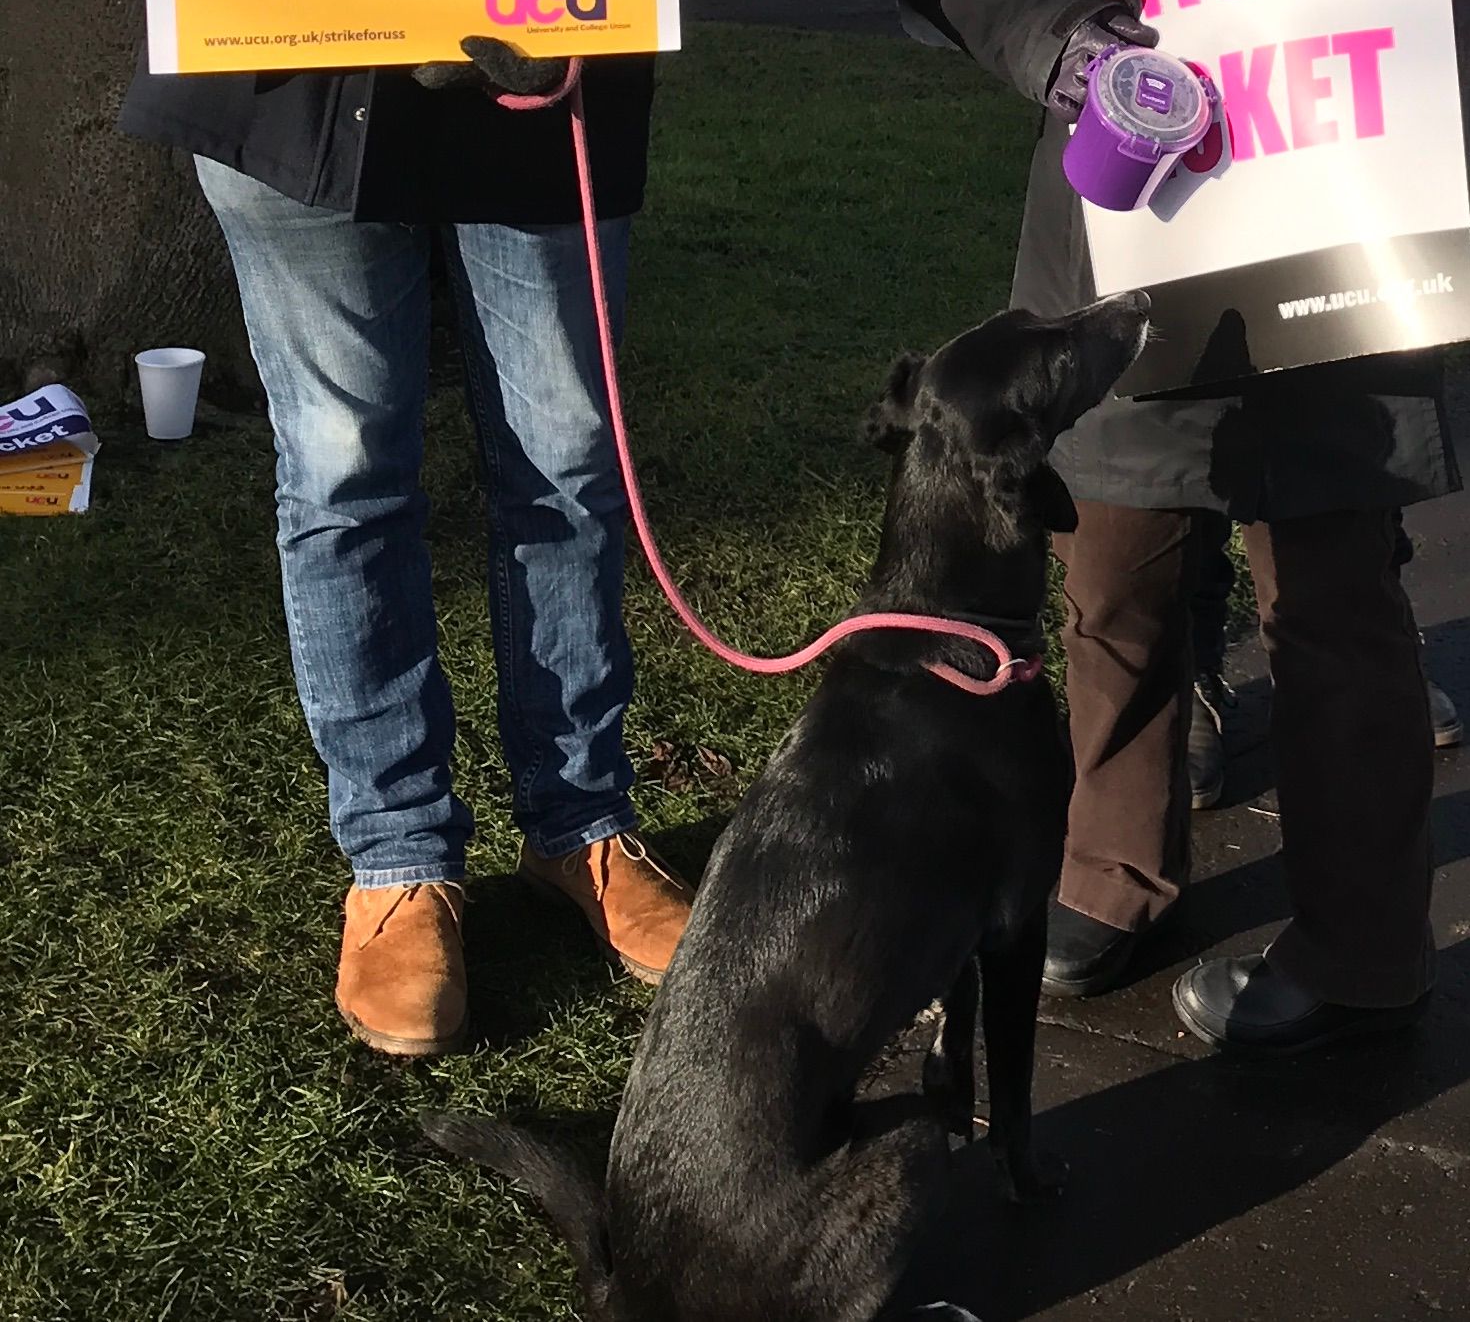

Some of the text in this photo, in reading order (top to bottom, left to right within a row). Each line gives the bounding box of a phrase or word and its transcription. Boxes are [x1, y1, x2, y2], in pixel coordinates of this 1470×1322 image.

[204, 28, 406, 48] www.ucu.org.uk/strikeforuss
[526, 25, 563, 34] University
[565, 24, 579, 32] and
[1190, 28, 1394, 162] KET
[1278, 273, 1454, 320] www.ucu.o.uk
